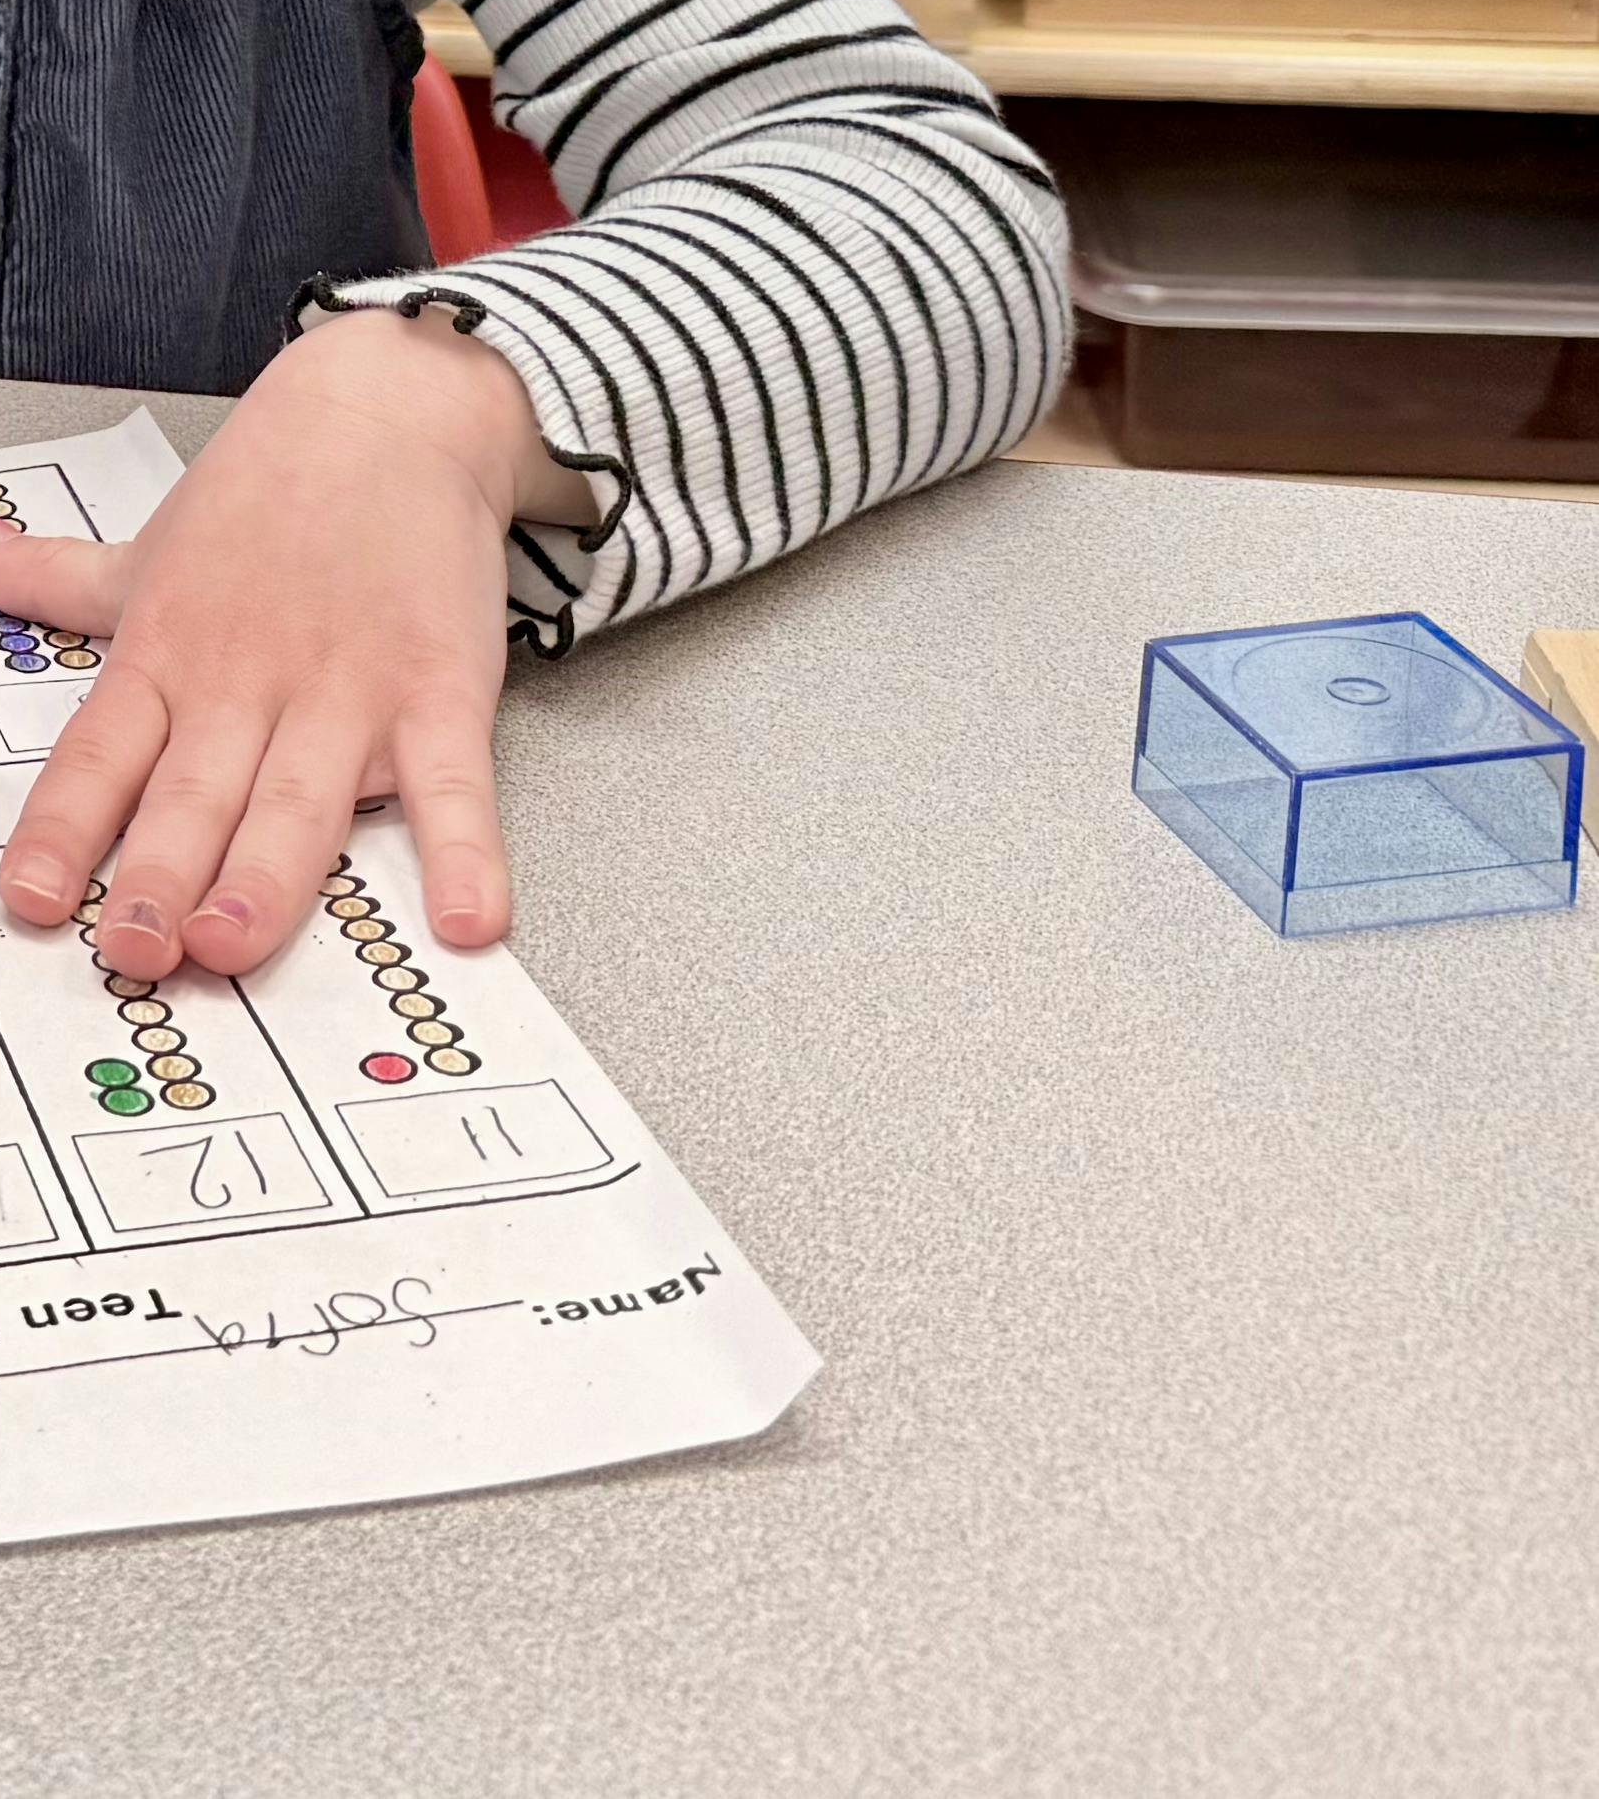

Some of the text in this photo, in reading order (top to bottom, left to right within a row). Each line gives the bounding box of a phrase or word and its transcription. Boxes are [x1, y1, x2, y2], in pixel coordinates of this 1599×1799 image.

[461, 1105, 523, 1162] 11
[140, 1130, 268, 1210] 12
[20, 1287, 183, 1329] Teen
[532, 1251, 722, 1327] Name:
